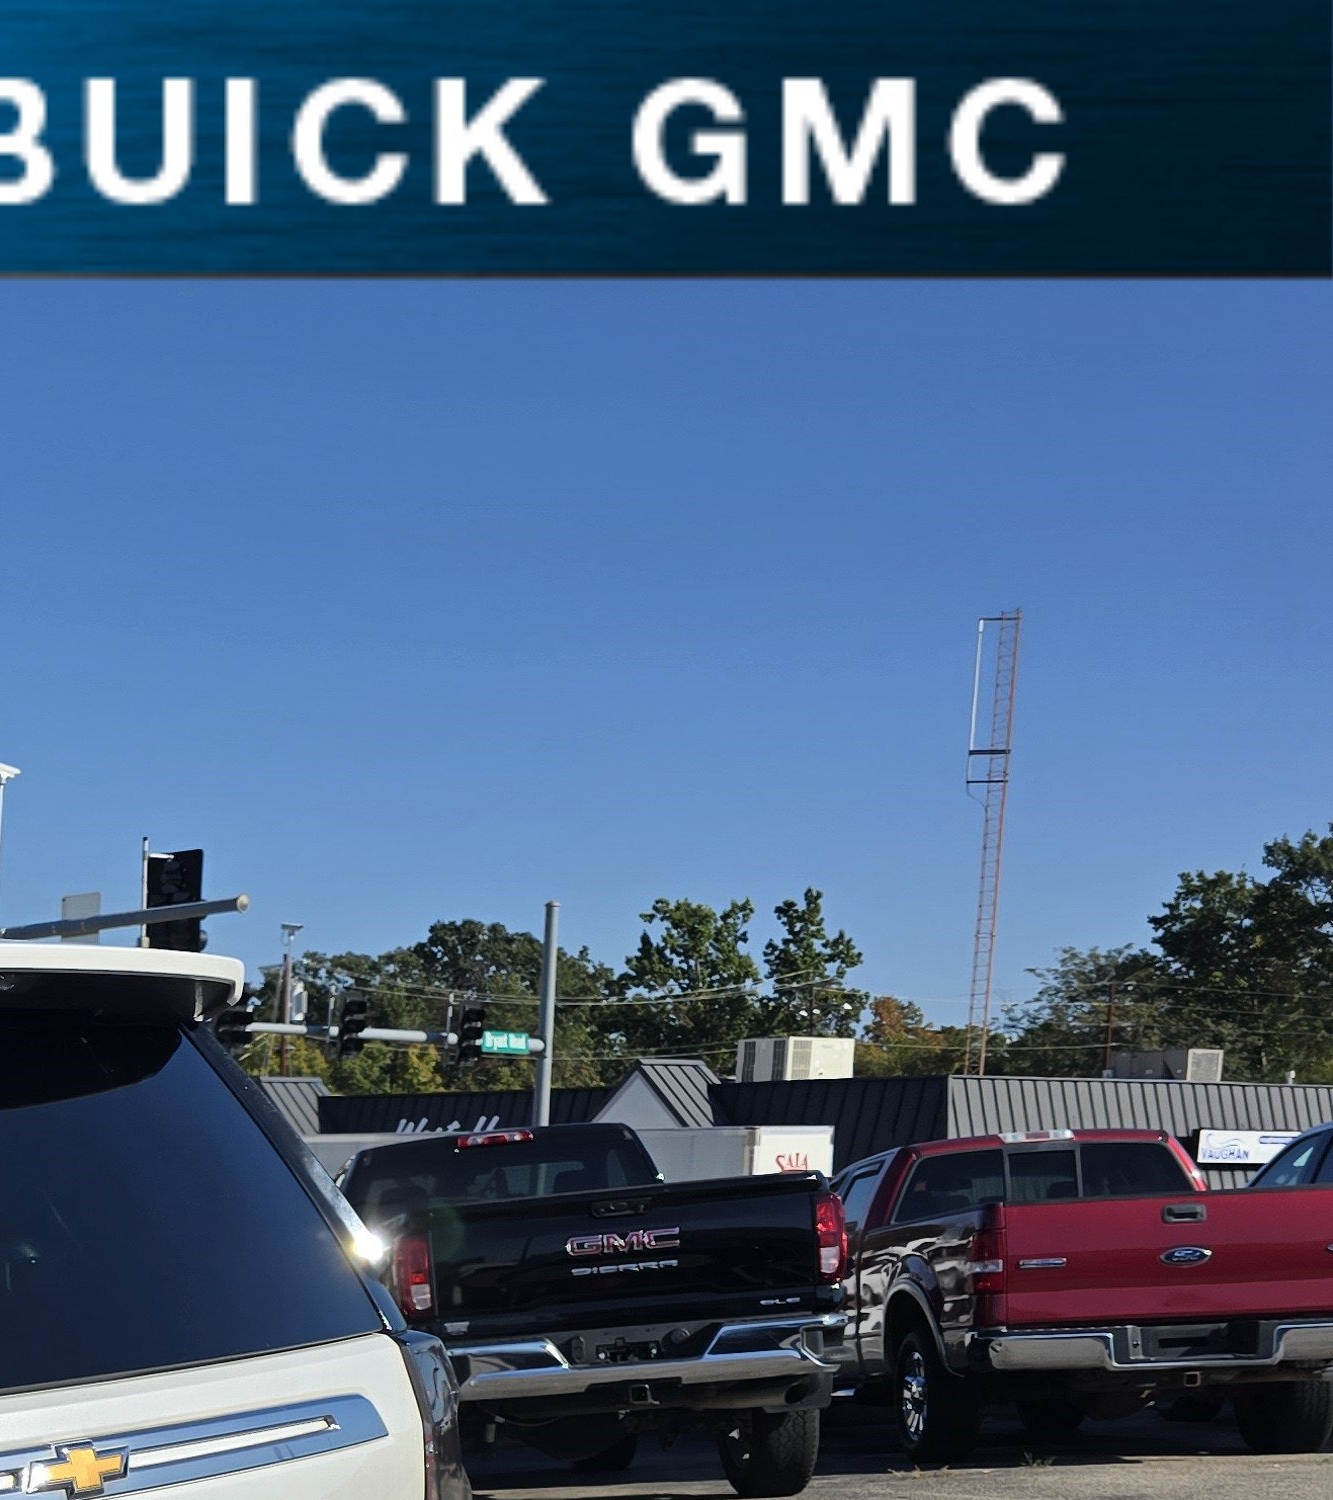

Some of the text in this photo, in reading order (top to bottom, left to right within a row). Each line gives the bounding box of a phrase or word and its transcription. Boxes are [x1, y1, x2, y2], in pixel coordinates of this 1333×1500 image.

[1200, 1147, 1250, 1161] VAUGHAN
[565, 1227, 680, 1256] GMC
[571, 1260, 679, 1276] SIERRA
